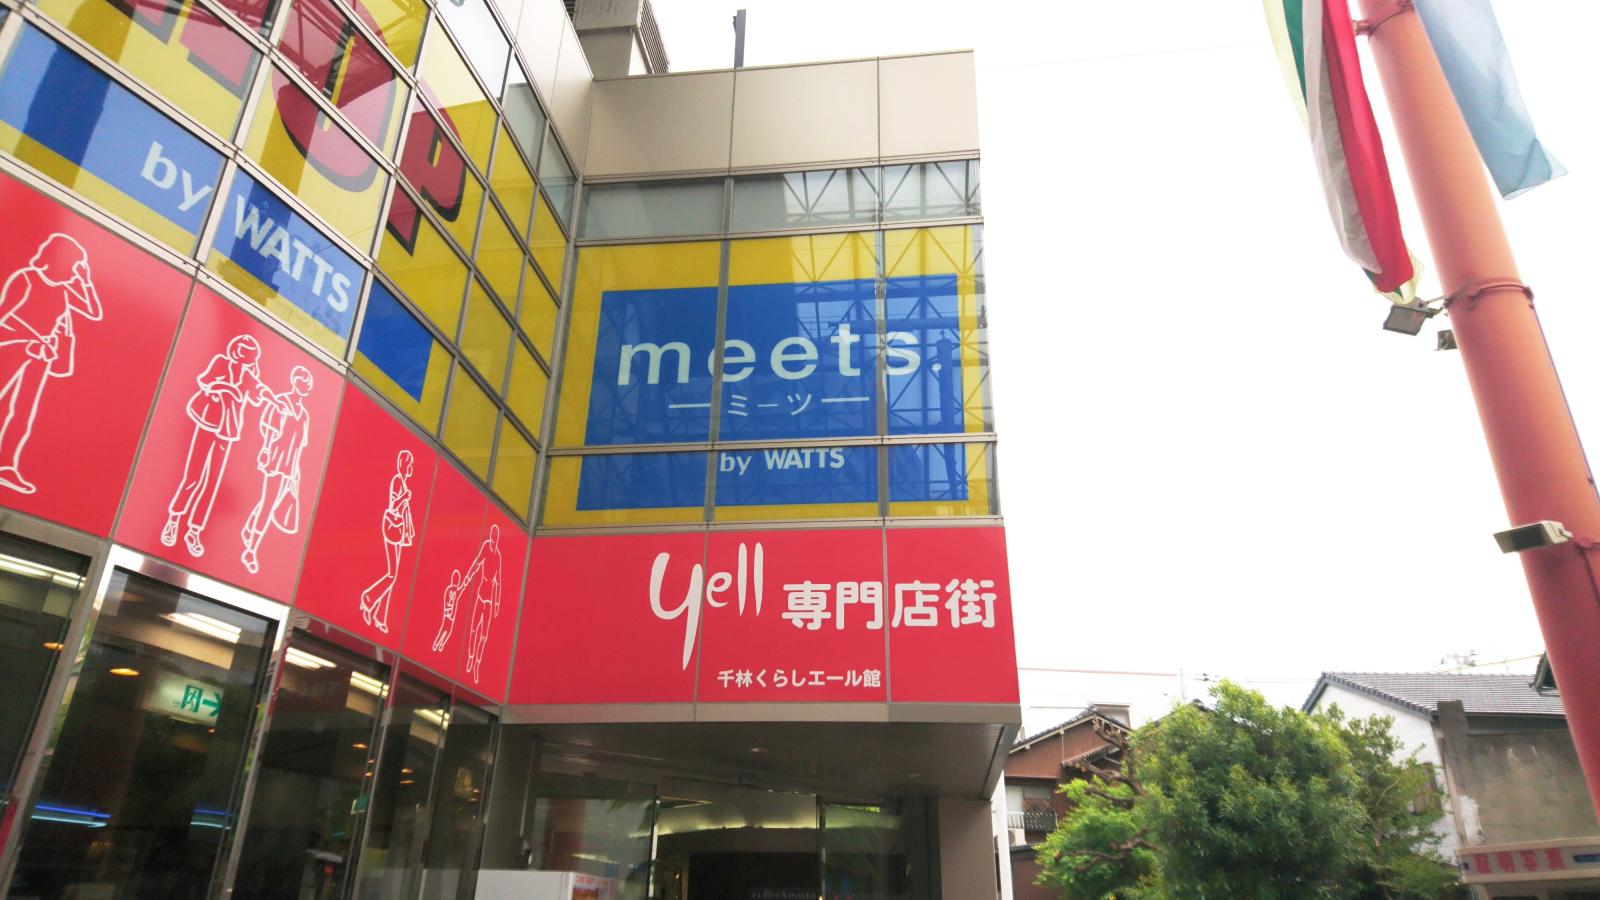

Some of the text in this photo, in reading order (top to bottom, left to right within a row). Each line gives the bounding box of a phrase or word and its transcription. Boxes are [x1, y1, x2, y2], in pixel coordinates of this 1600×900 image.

[141, 141, 352, 313] by WATTS
[728, 393, 812, 416] ミーツ
[719, 447, 845, 475] by WATTS
[649, 542, 764, 671] yell
[781, 578, 997, 630] 専門店街
[717, 669, 881, 688] 千林くらしエール館
